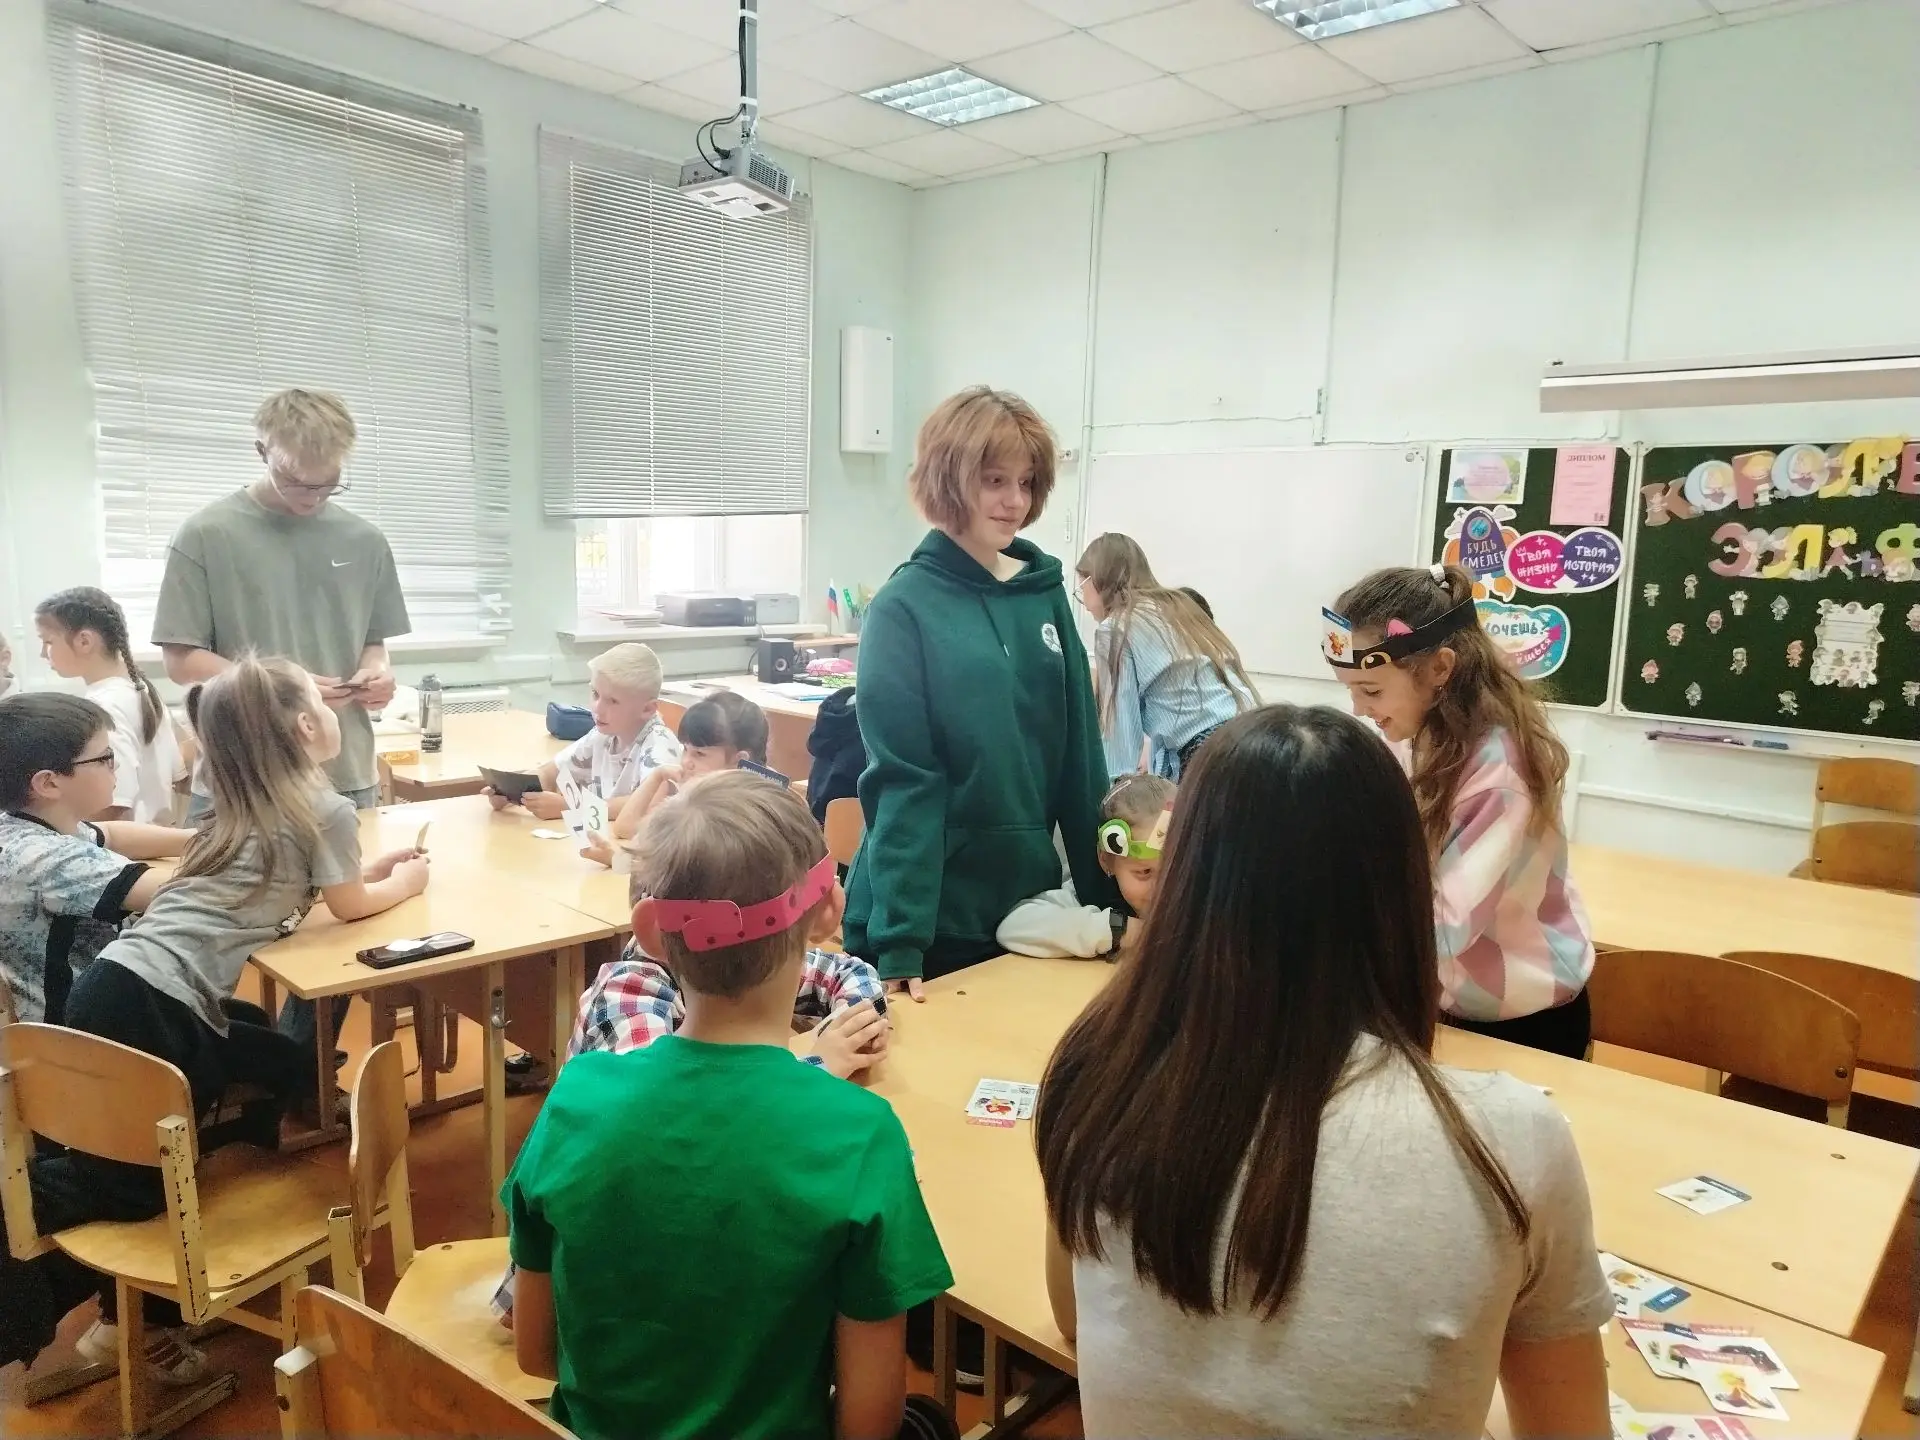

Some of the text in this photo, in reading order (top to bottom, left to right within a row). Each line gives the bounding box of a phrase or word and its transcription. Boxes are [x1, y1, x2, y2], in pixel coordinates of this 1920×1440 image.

[1566, 453, 1606, 462] ДИПЛОМ
[1467, 539, 1498, 555] БУДЬ
[1574, 545, 1608, 558] ТВОЯ
[1516, 549, 1552, 564] ТВОЯ
[1516, 562, 1558, 578] ЖИЗНЬ
[1563, 559, 1616, 574] ИСТОРИЯ
[588, 805, 601, 831] 3
